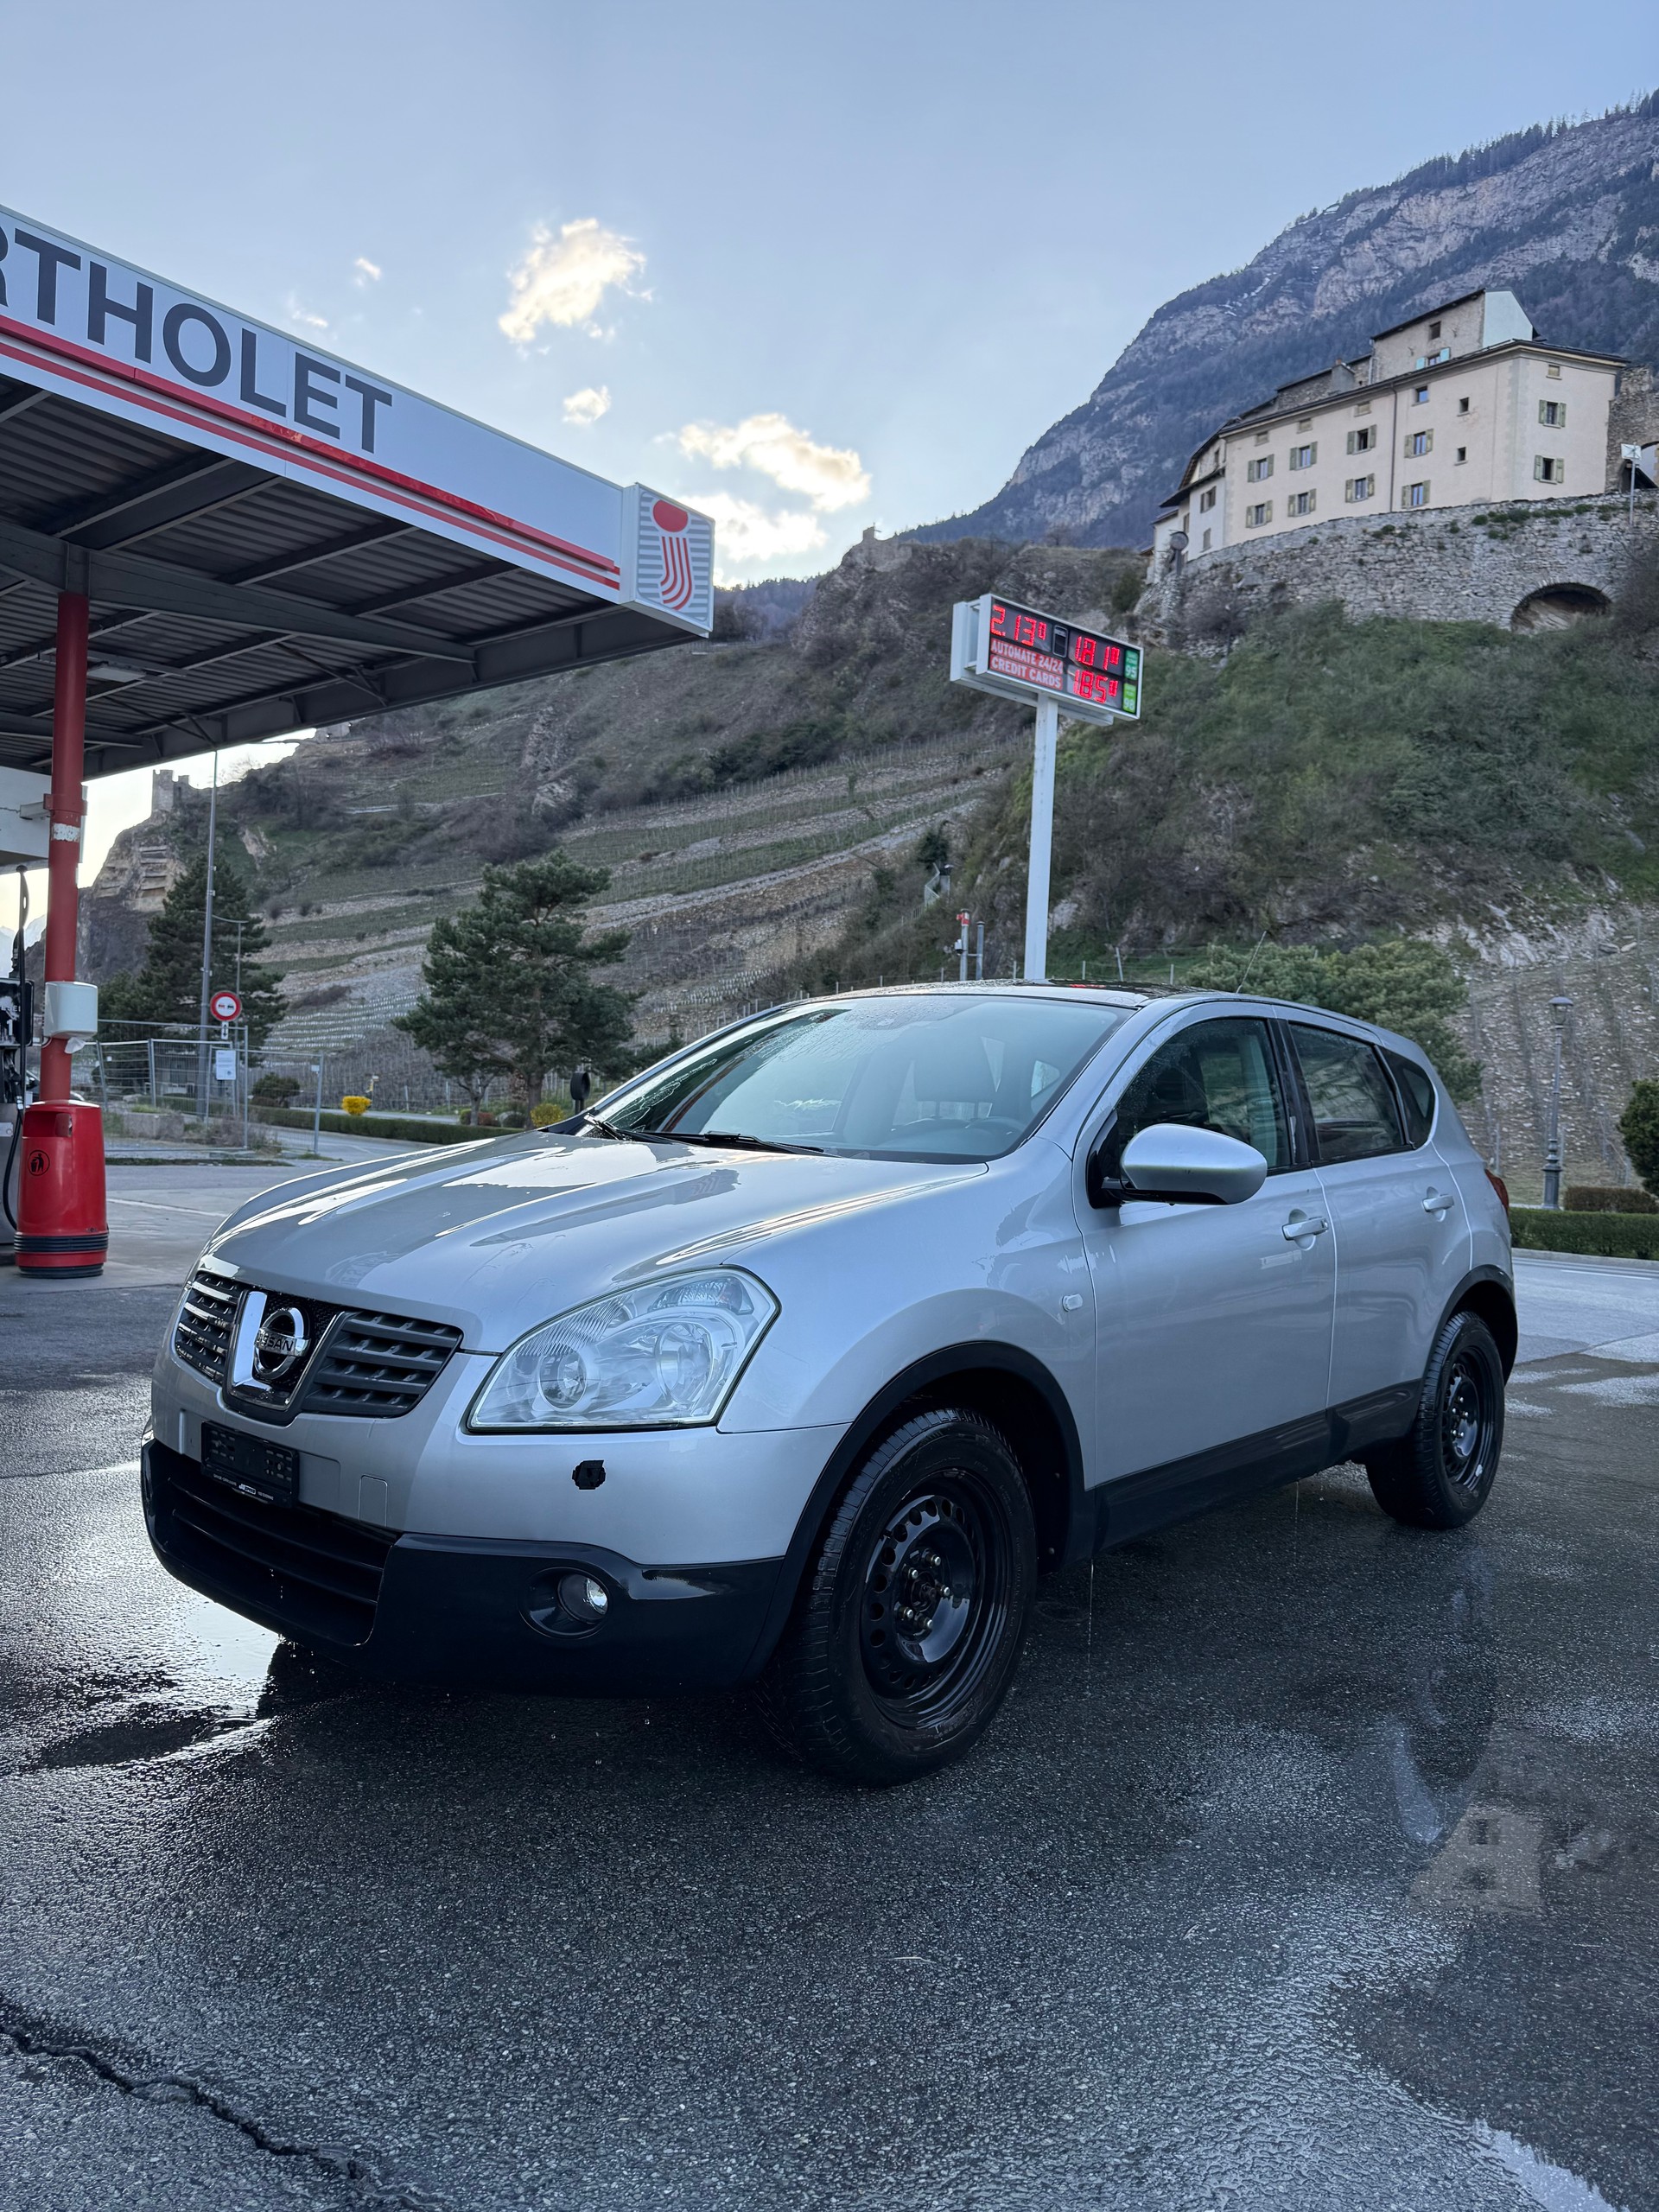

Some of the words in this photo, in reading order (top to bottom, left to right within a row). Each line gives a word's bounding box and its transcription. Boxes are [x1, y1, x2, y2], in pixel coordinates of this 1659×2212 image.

[0, 226, 392, 454] THOLET
[991, 640, 1034, 665] AUTOMATE
[1035, 658, 1064, 674] 24/24
[991, 657, 1027, 678] CREDIT
[1028, 668, 1062, 689] CARDS
[1126, 664, 1137, 678] 95
[1124, 697, 1135, 711] 98
[7, 1019, 13, 1035] 1
[257, 1332, 295, 1352] SSAN
